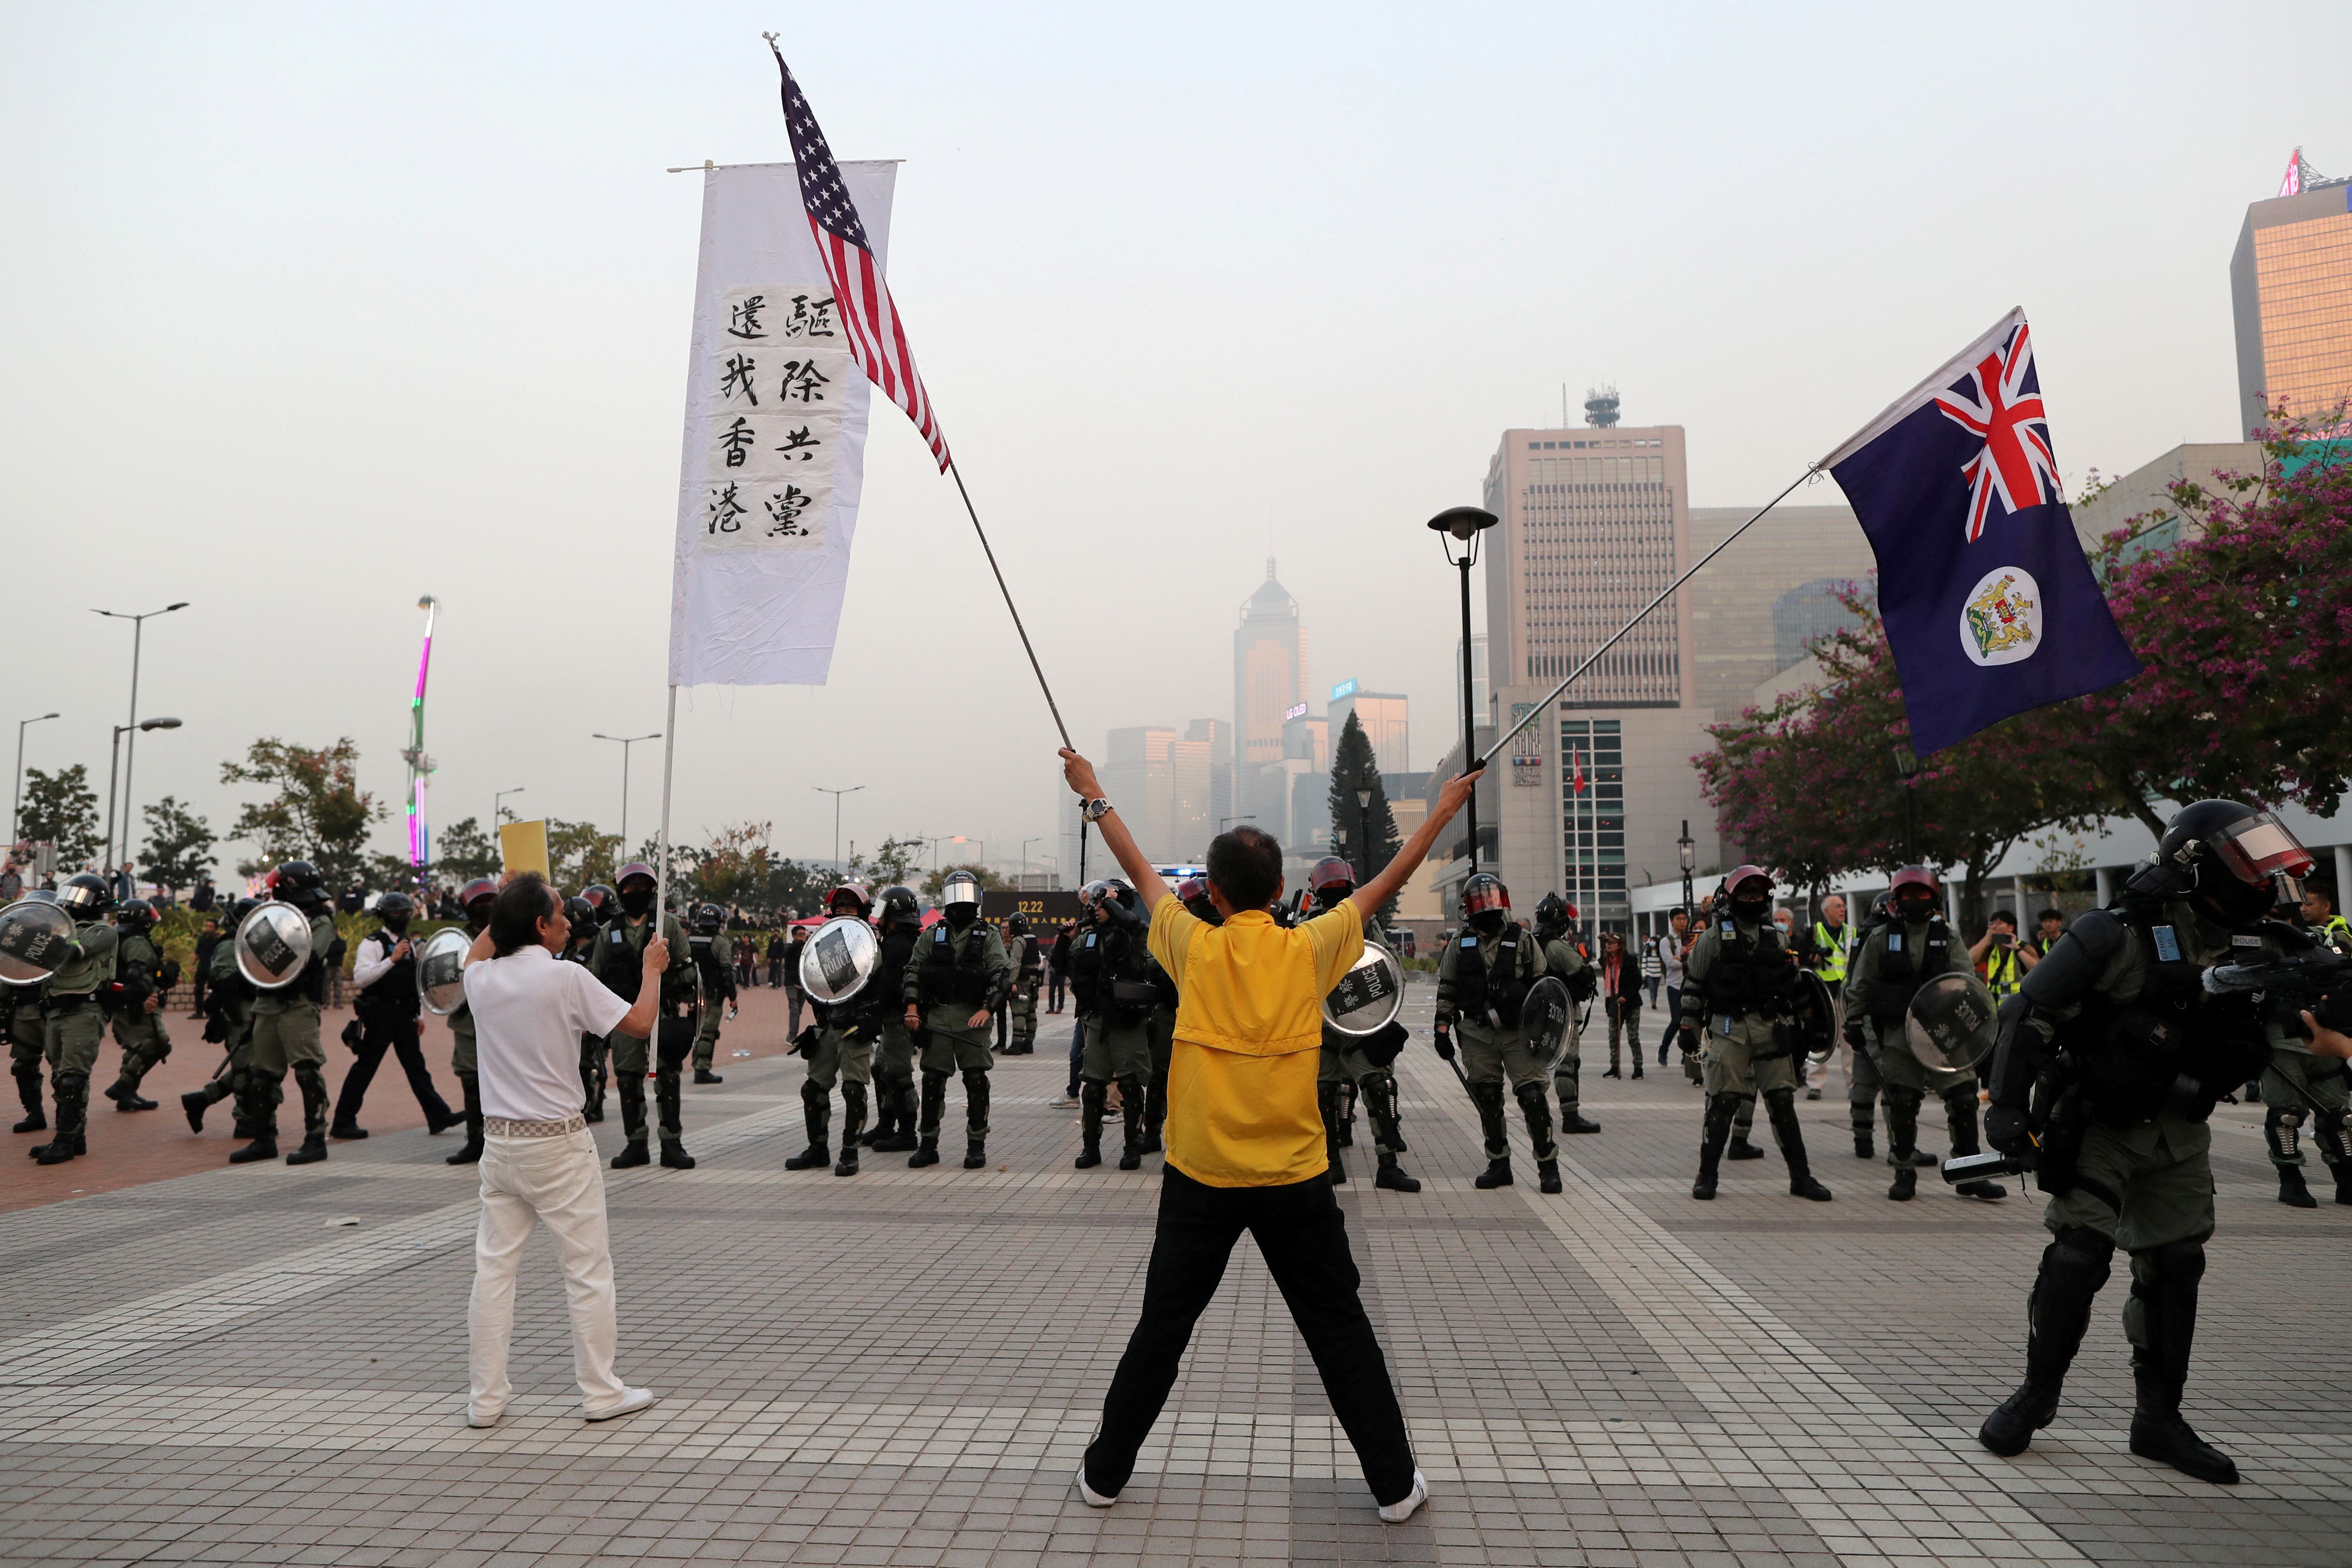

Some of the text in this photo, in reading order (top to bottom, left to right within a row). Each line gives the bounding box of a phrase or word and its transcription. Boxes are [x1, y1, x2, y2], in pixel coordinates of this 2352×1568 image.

[709, 295, 770, 535] 還我香港
[764, 295, 836, 537] 驅除共黨
[1286, 703, 1306, 720] LG OLED
[1018, 901, 1043, 913] 12.22
[25, 932, 52, 960] POLICE
[2162, 950, 2169, 959] EU
[823, 950, 851, 977] POLICE
[1339, 978, 1359, 1008] 警察
[1362, 965, 1384, 998] POLICE
[1548, 1002, 1565, 1024] POLICE
[1954, 999, 1981, 1031] POLICE
